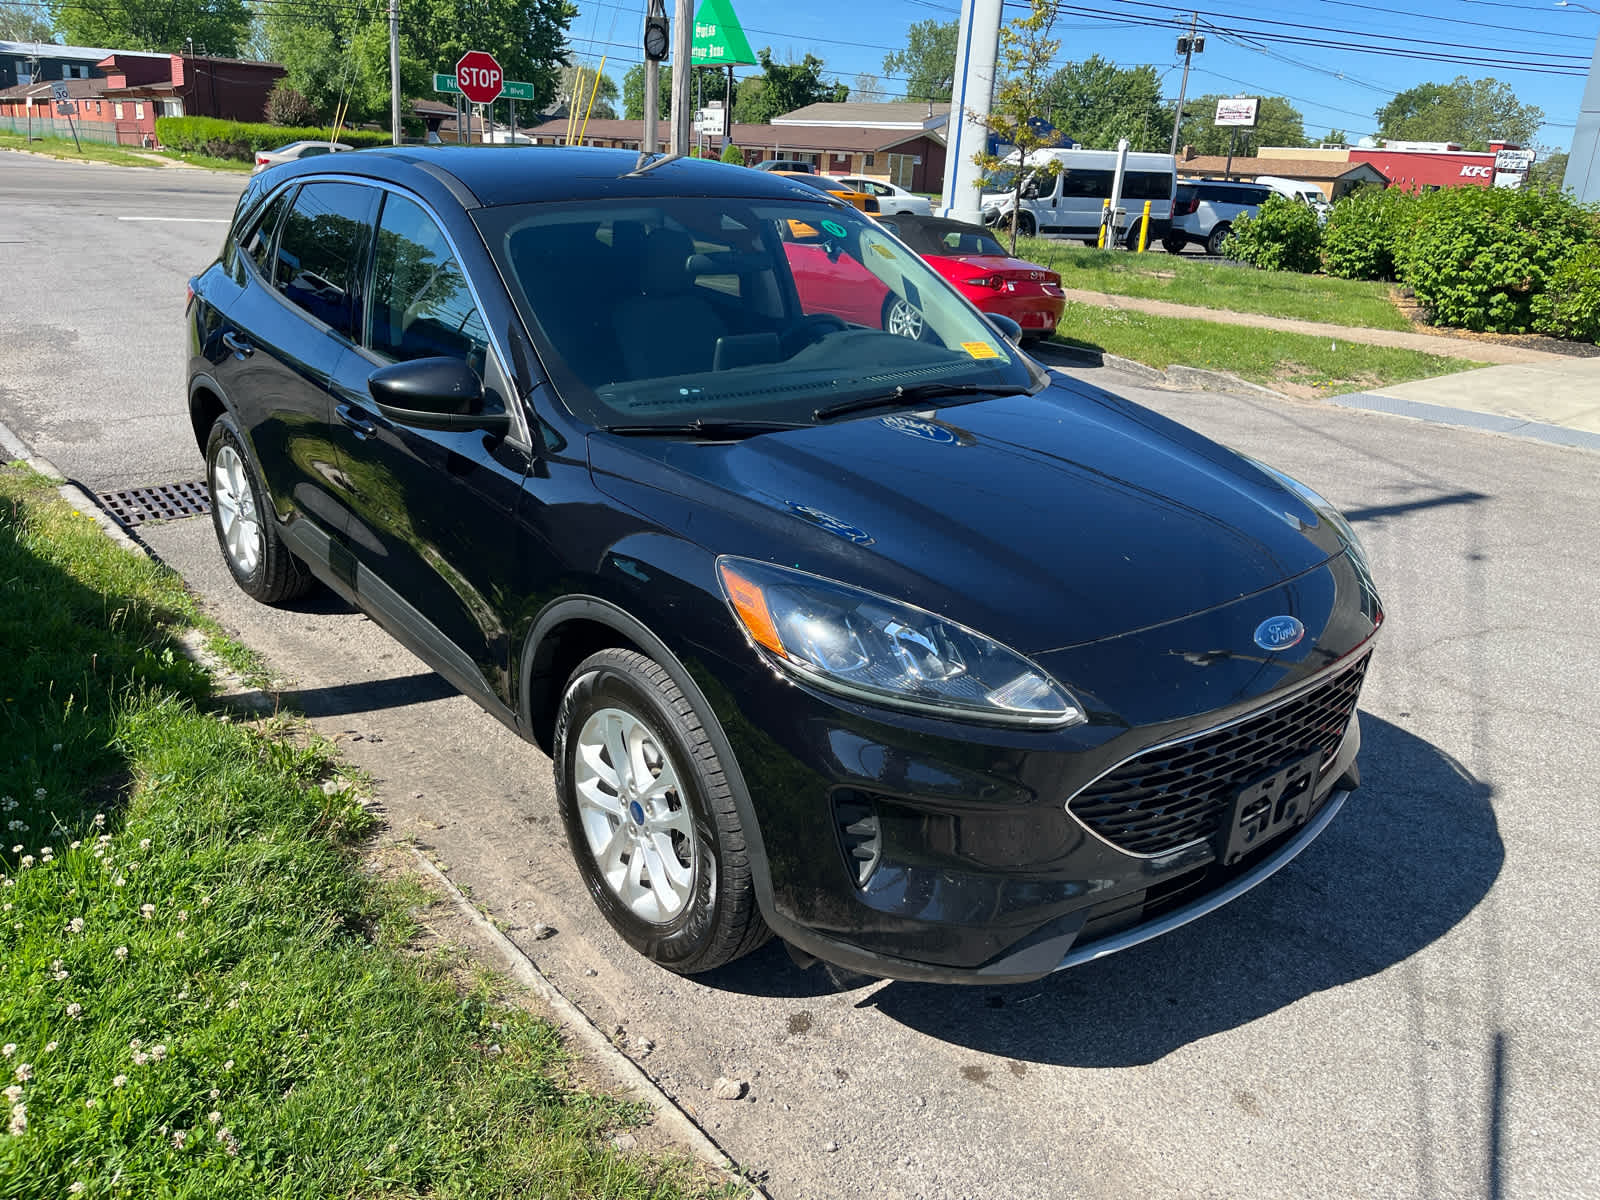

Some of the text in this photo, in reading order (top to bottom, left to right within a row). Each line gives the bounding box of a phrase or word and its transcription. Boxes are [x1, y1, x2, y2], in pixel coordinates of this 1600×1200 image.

[460, 66, 500, 89] STOP
[56, 90, 68, 99] 30
[510, 87, 524, 95] Blvd
[1460, 165, 1492, 178] KFC
[1268, 622, 1297, 643] Ford
